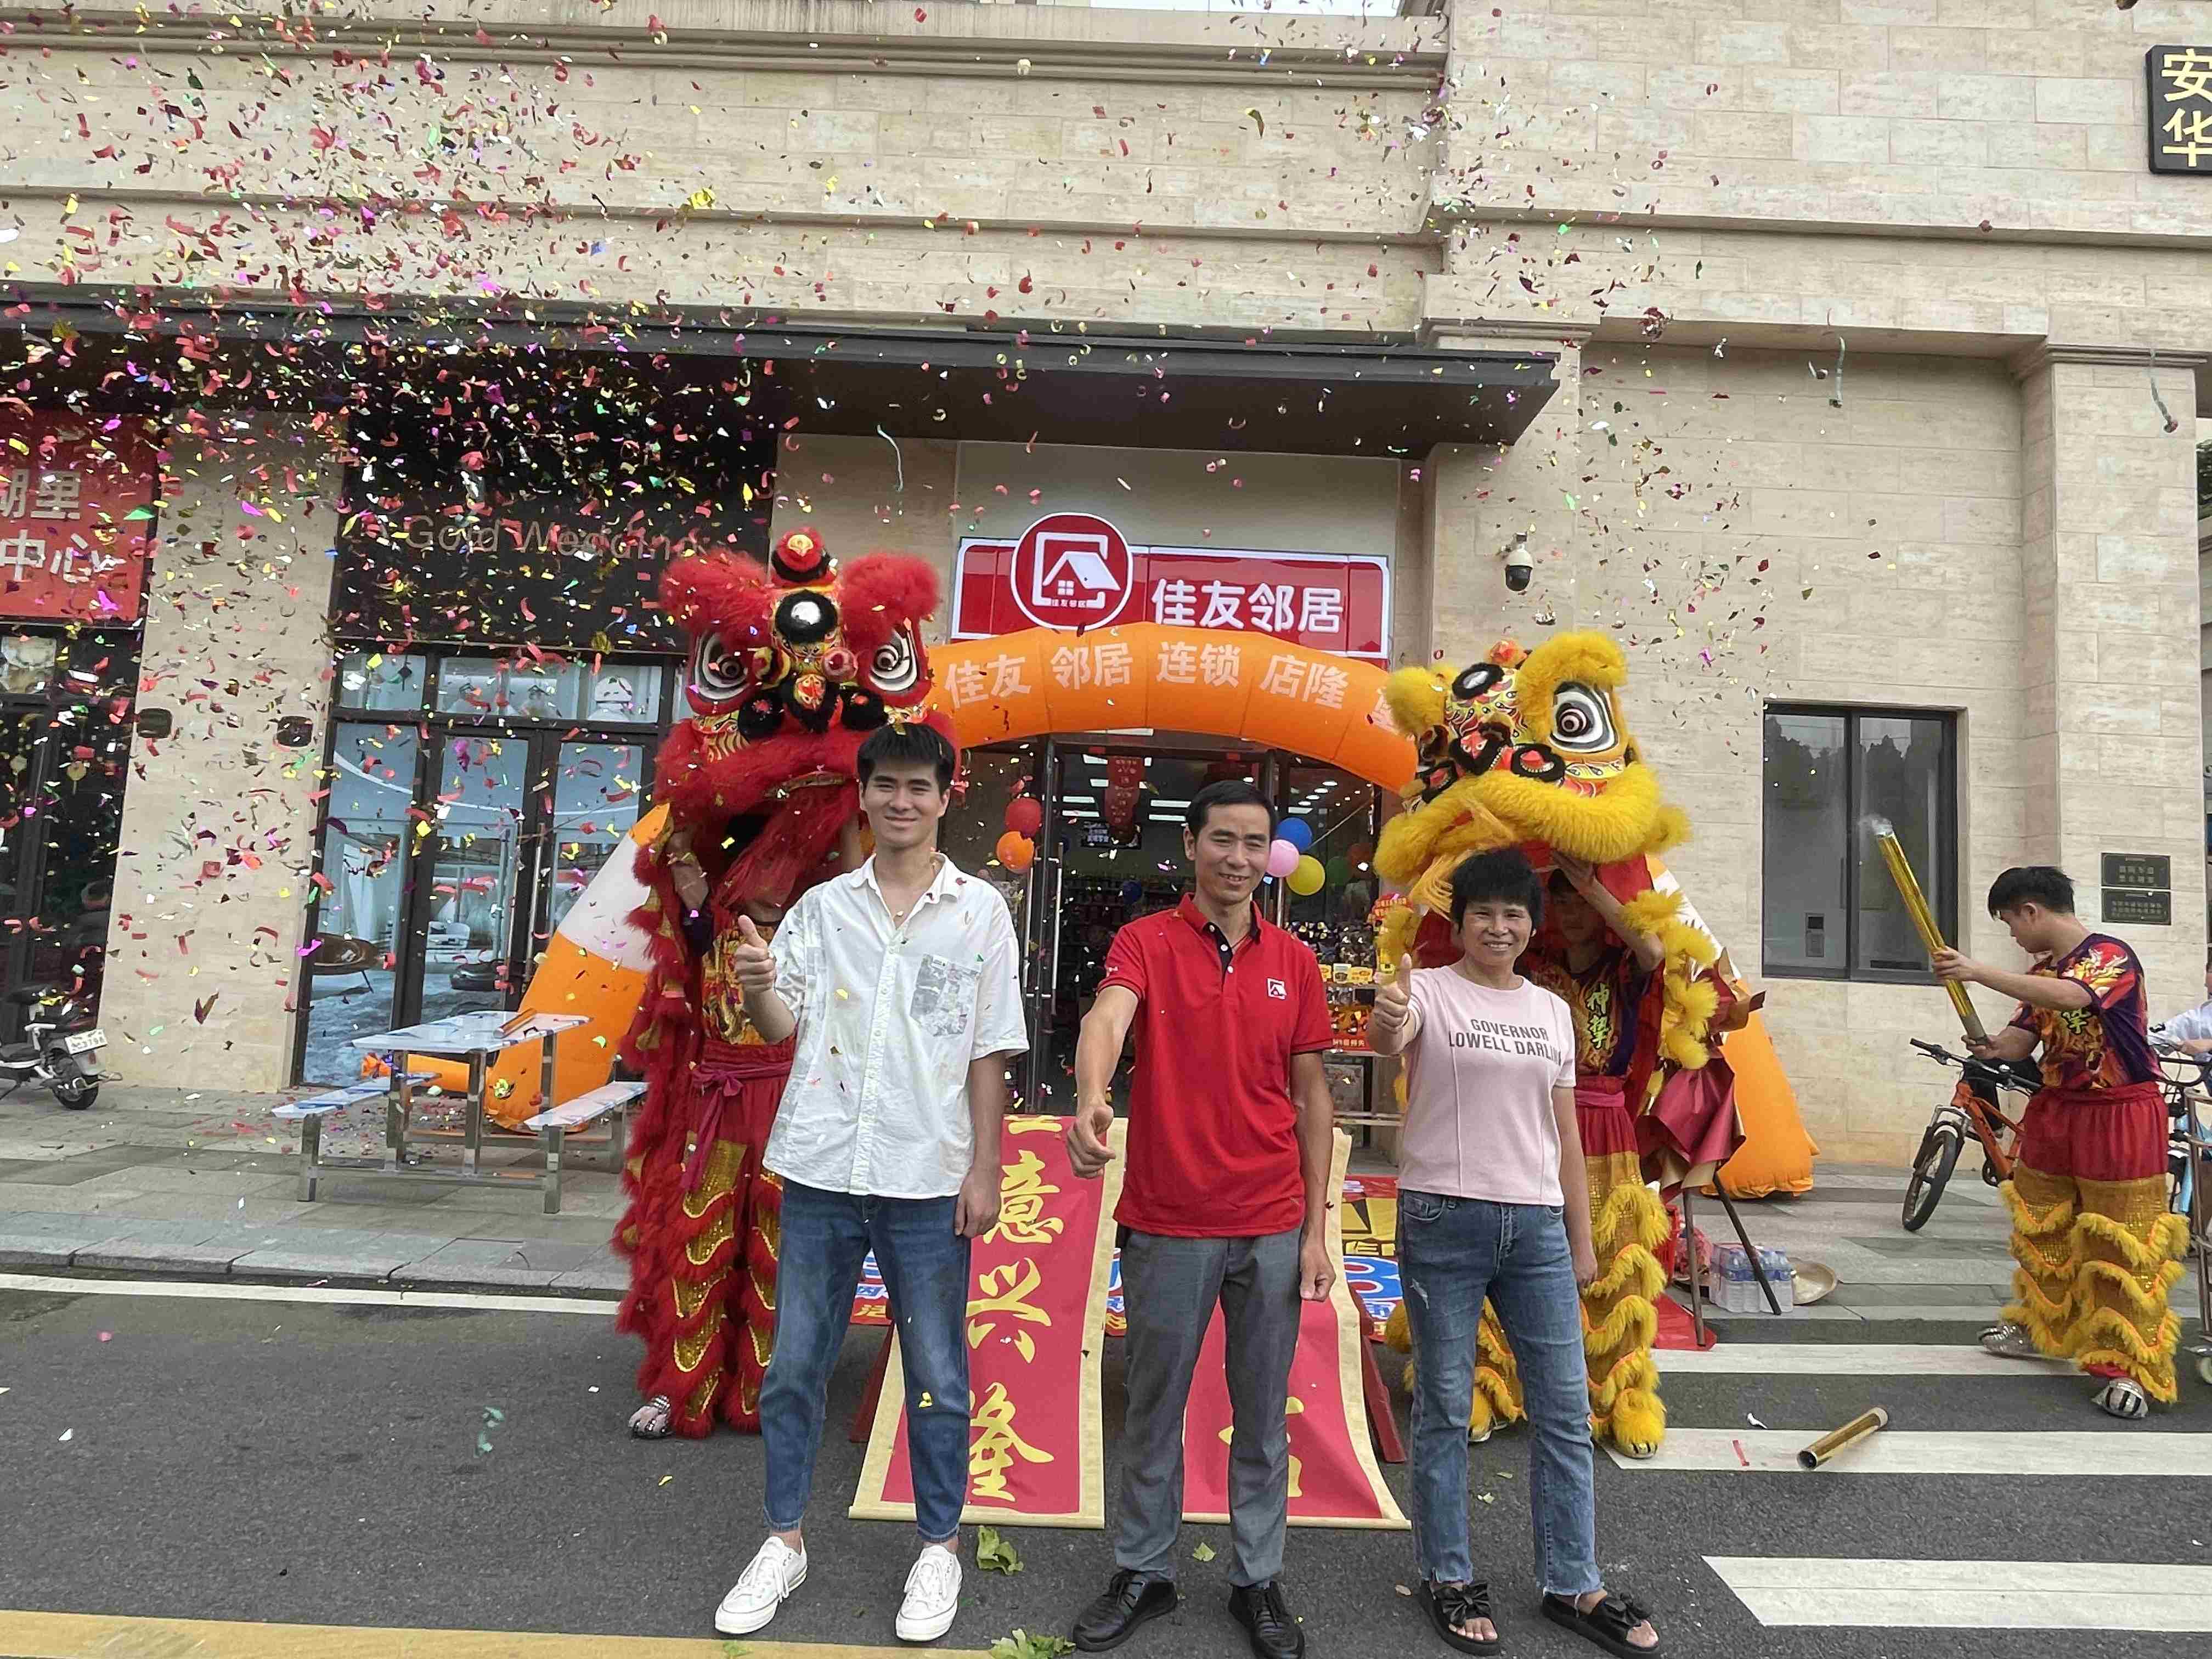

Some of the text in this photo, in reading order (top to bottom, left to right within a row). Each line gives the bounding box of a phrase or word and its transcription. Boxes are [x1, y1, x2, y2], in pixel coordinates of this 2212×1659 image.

[2162, 48, 2212, 167] 安华
[405, 515, 500, 552] God
[1152, 578, 1343, 633] 佳友邻居
[1448, 1031, 1511, 1053] LOWELL
[1471, 1019, 1549, 1041] GOVERNOR
